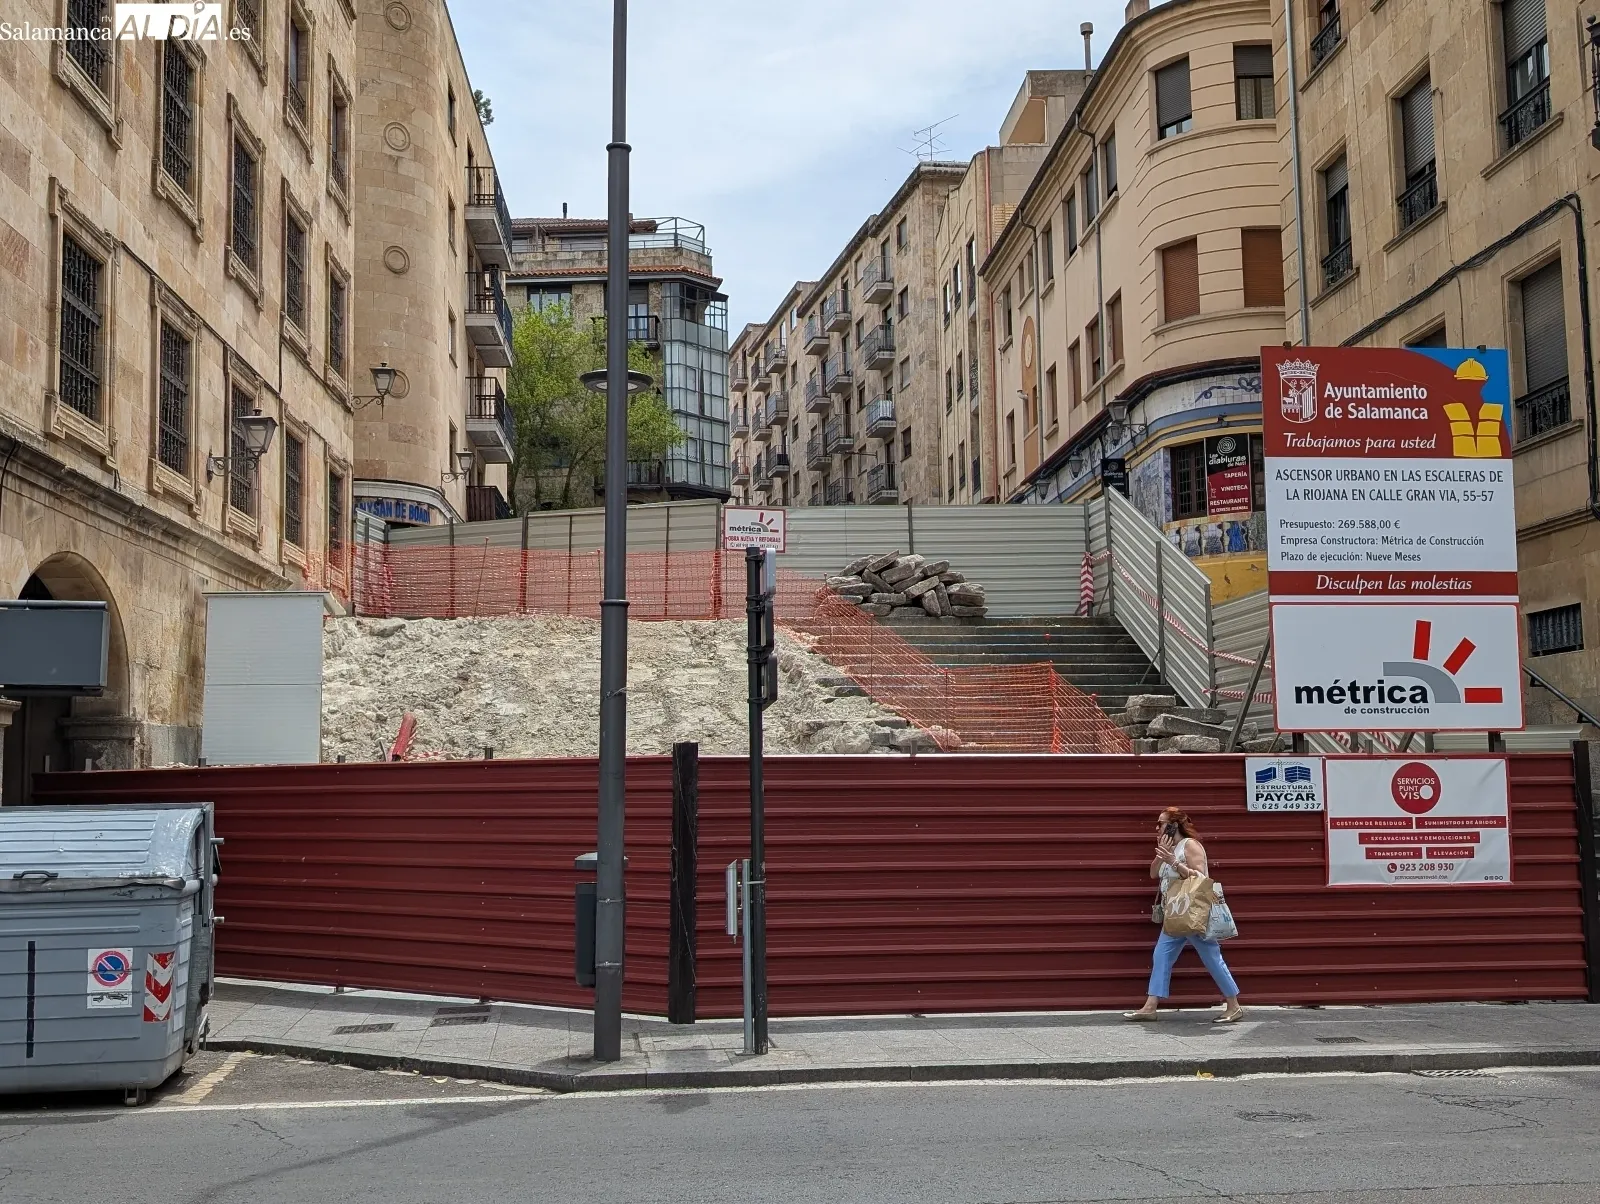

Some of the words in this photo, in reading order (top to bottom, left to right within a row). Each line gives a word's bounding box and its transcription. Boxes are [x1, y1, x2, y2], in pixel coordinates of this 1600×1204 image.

[1324, 382, 1428, 401] Ayuntamiento
[1325, 403, 1342, 419] de
[1348, 403, 1428, 420] Salamanca
[1283, 432, 1361, 453] Trabajamos
[1365, 437, 1396, 453] para
[1400, 434, 1436, 449] usted
[1208, 455, 1246, 466] diabluras
[1276, 470, 1332, 482] ASCENSOR
[1336, 470, 1380, 482] URBANO
[1384, 470, 1398, 482] EN
[1401, 470, 1422, 482] LAS
[1425, 470, 1486, 482] ESCALERAS
[1489, 470, 1504, 482] DE
[1210, 498, 1248, 506] RESTAURANTE
[1286, 489, 1300, 500] LA
[1304, 489, 1348, 501] RIOJANA
[1352, 489, 1366, 500] EN
[1369, 489, 1402, 501] CALLE
[1406, 490, 1436, 501] GRAN
[1438, 490, 1460, 503] VIA,
[1463, 490, 1494, 502] 55-57
[1280, 519, 1335, 531] Presupuesto:
[1338, 519, 1391, 530] 269.588,00
[1394, 520, 1400, 529] €
[1280, 536, 1318, 547] Empresa
[1320, 535, 1378, 546] Constructora:
[1381, 535, 1414, 546] Métrica
[1416, 536, 1427, 546] de
[1429, 535, 1484, 546] Construcción
[1281, 552, 1304, 561] Plazo
[1307, 552, 1318, 561] de
[1320, 552, 1363, 563] ejecución:
[1366, 552, 1392, 561] Nueve
[1395, 552, 1421, 562] Meses
[1316, 574, 1383, 594] Disculpen
[1388, 574, 1406, 590] las
[1411, 576, 1472, 590] molestias
[1294, 678, 1428, 704] métrica
[1344, 706, 1357, 714] de
[1360, 705, 1430, 714] construcción
[1256, 793, 1316, 802] PAYCAR
